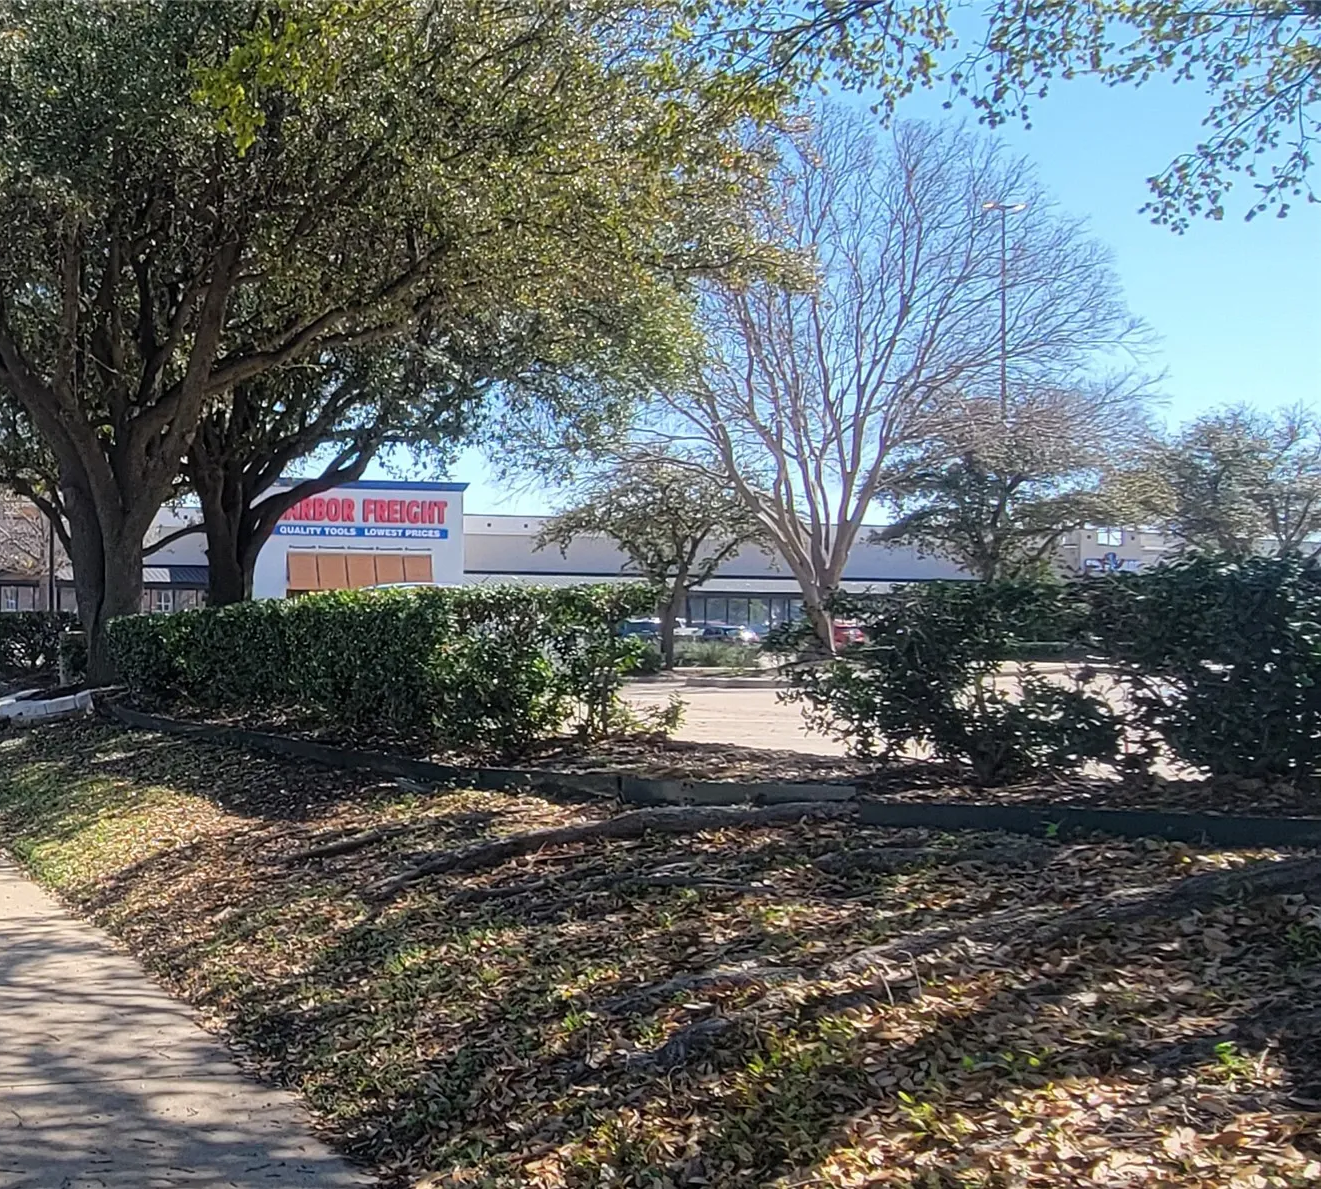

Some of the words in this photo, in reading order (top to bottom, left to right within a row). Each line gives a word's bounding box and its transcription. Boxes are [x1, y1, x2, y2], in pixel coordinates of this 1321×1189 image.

[362, 498, 448, 524] FREIGHT
[280, 526, 322, 535] QUALITY
[324, 527, 357, 536] TOOLS
[364, 528, 404, 537] LOWEST
[405, 529, 441, 538] PRICES
